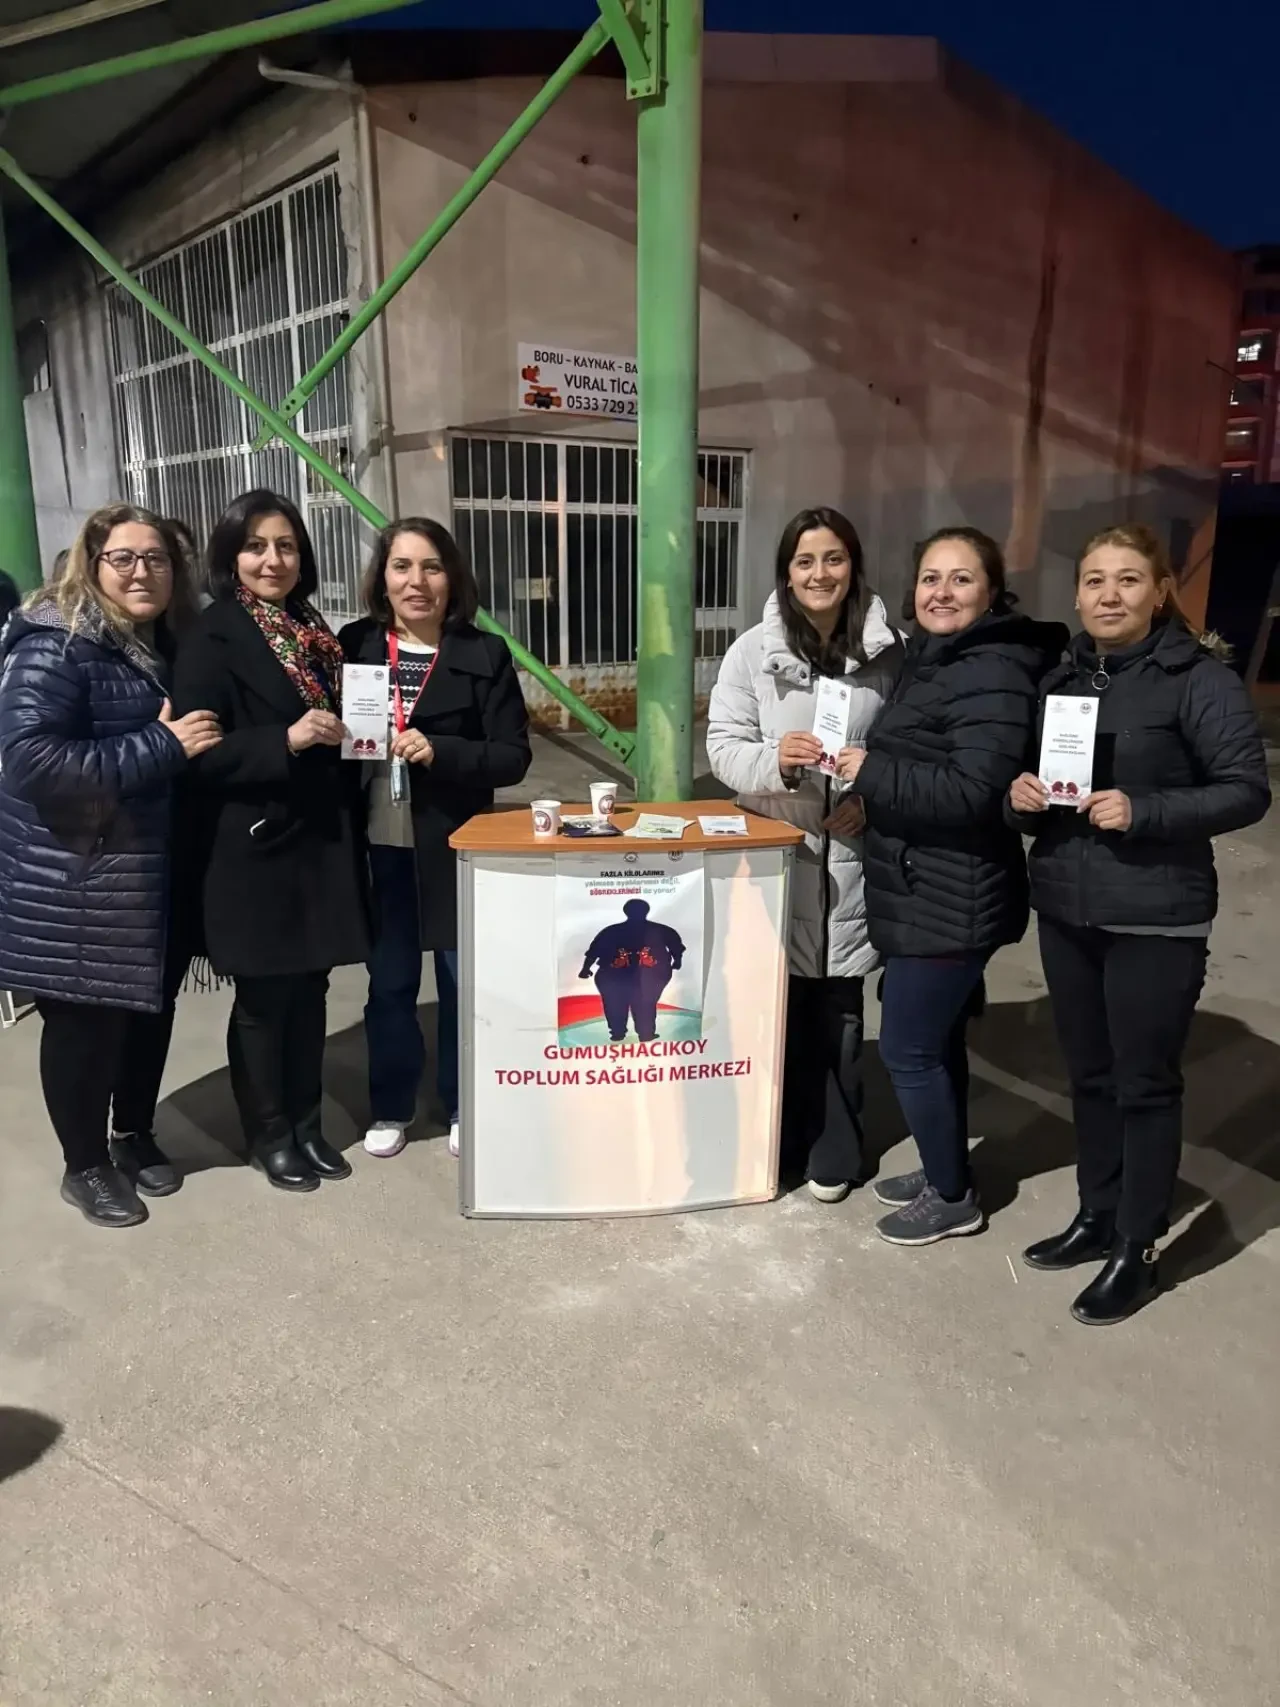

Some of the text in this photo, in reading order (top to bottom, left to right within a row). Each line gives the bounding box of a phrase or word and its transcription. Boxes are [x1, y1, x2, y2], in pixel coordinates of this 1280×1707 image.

[534, 350, 563, 364] BORU
[573, 355, 615, 371] KAYNAK
[625, 362, 638, 374] BA
[564, 373, 638, 395] VURAL TİCA
[567, 395, 638, 415] 0533 729 2
[600, 870, 622, 878] FAZLA
[495, 1056, 752, 1085] TOPLUM SAĞLIĞI MERKEZİ
